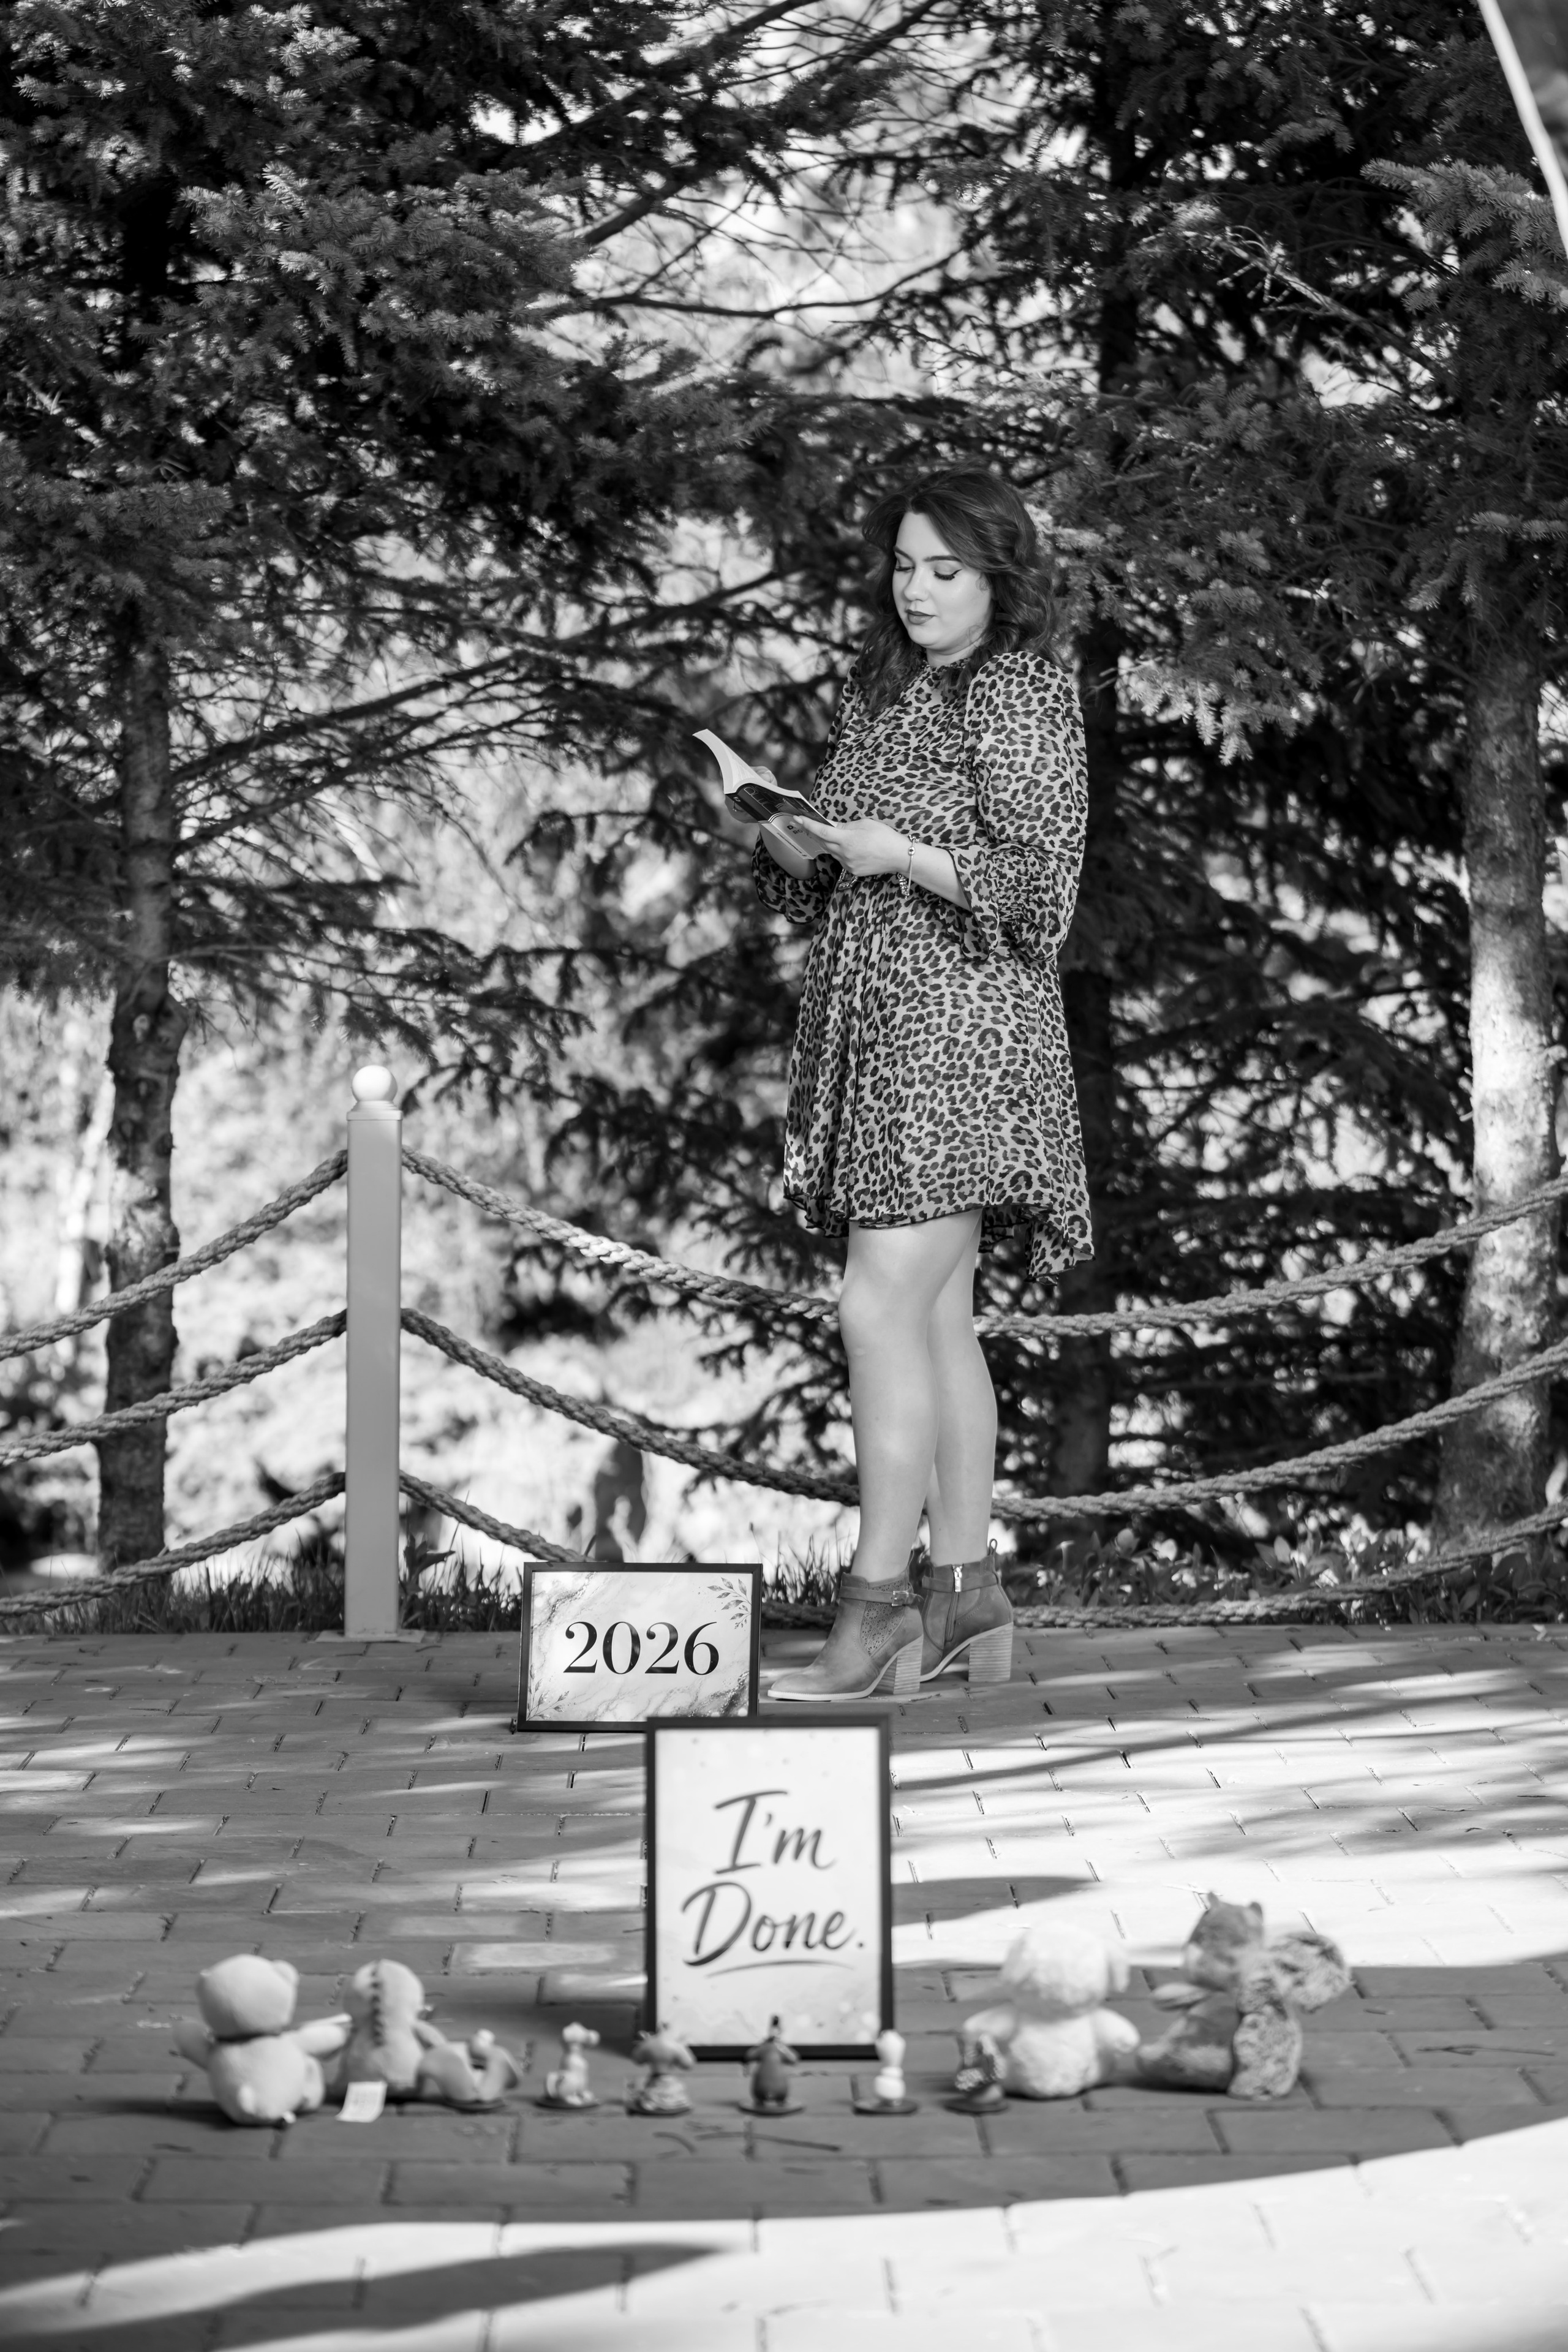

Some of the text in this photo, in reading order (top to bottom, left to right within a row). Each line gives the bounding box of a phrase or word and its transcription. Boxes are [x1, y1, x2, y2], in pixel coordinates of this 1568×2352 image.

[563, 1621, 720, 1675] 2026
[714, 1790, 836, 1875] I'm
[680, 1881, 864, 1967] Done.
